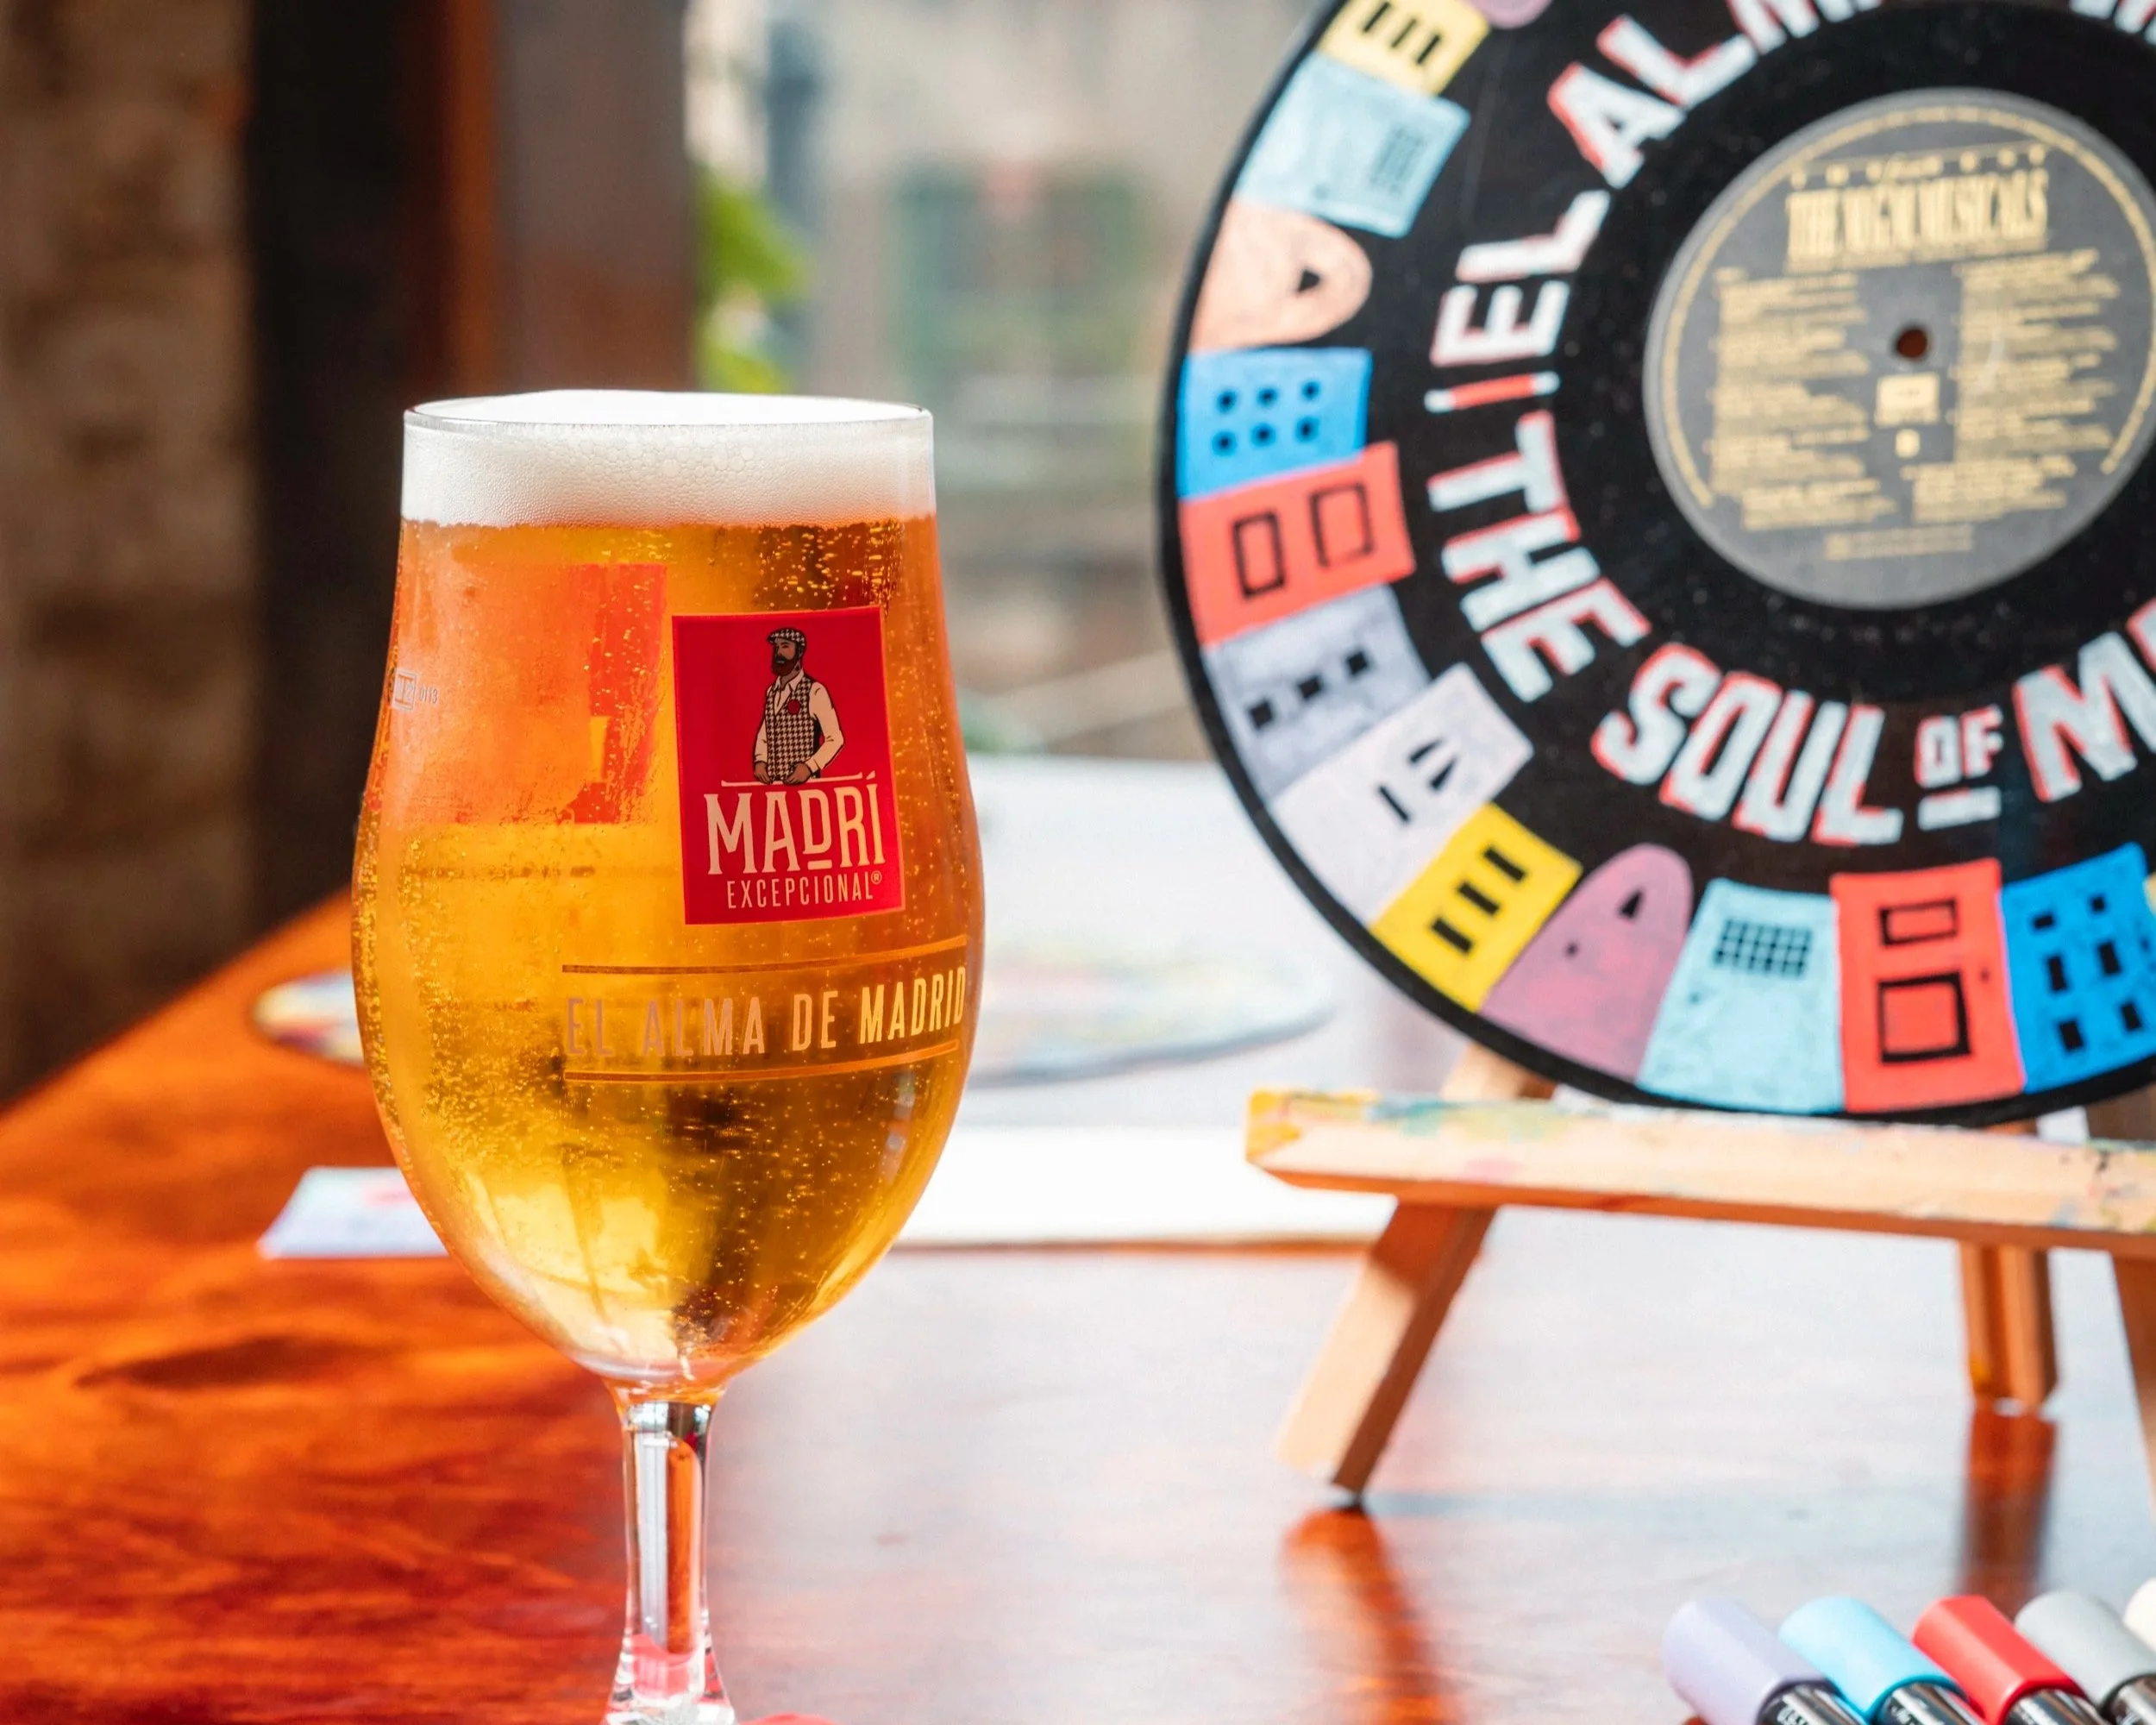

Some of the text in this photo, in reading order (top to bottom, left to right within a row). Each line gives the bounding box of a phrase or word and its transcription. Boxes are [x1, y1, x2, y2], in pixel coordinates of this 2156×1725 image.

[1430, 189, 1611, 367] EL
[1426, 409, 1652, 703] THE
[1590, 642, 1903, 846] SOUL
[1915, 705, 2003, 830] OF
[703, 771, 887, 876] MADRÍ
[566, 966, 968, 1057] EL ALMA DE MADRID
